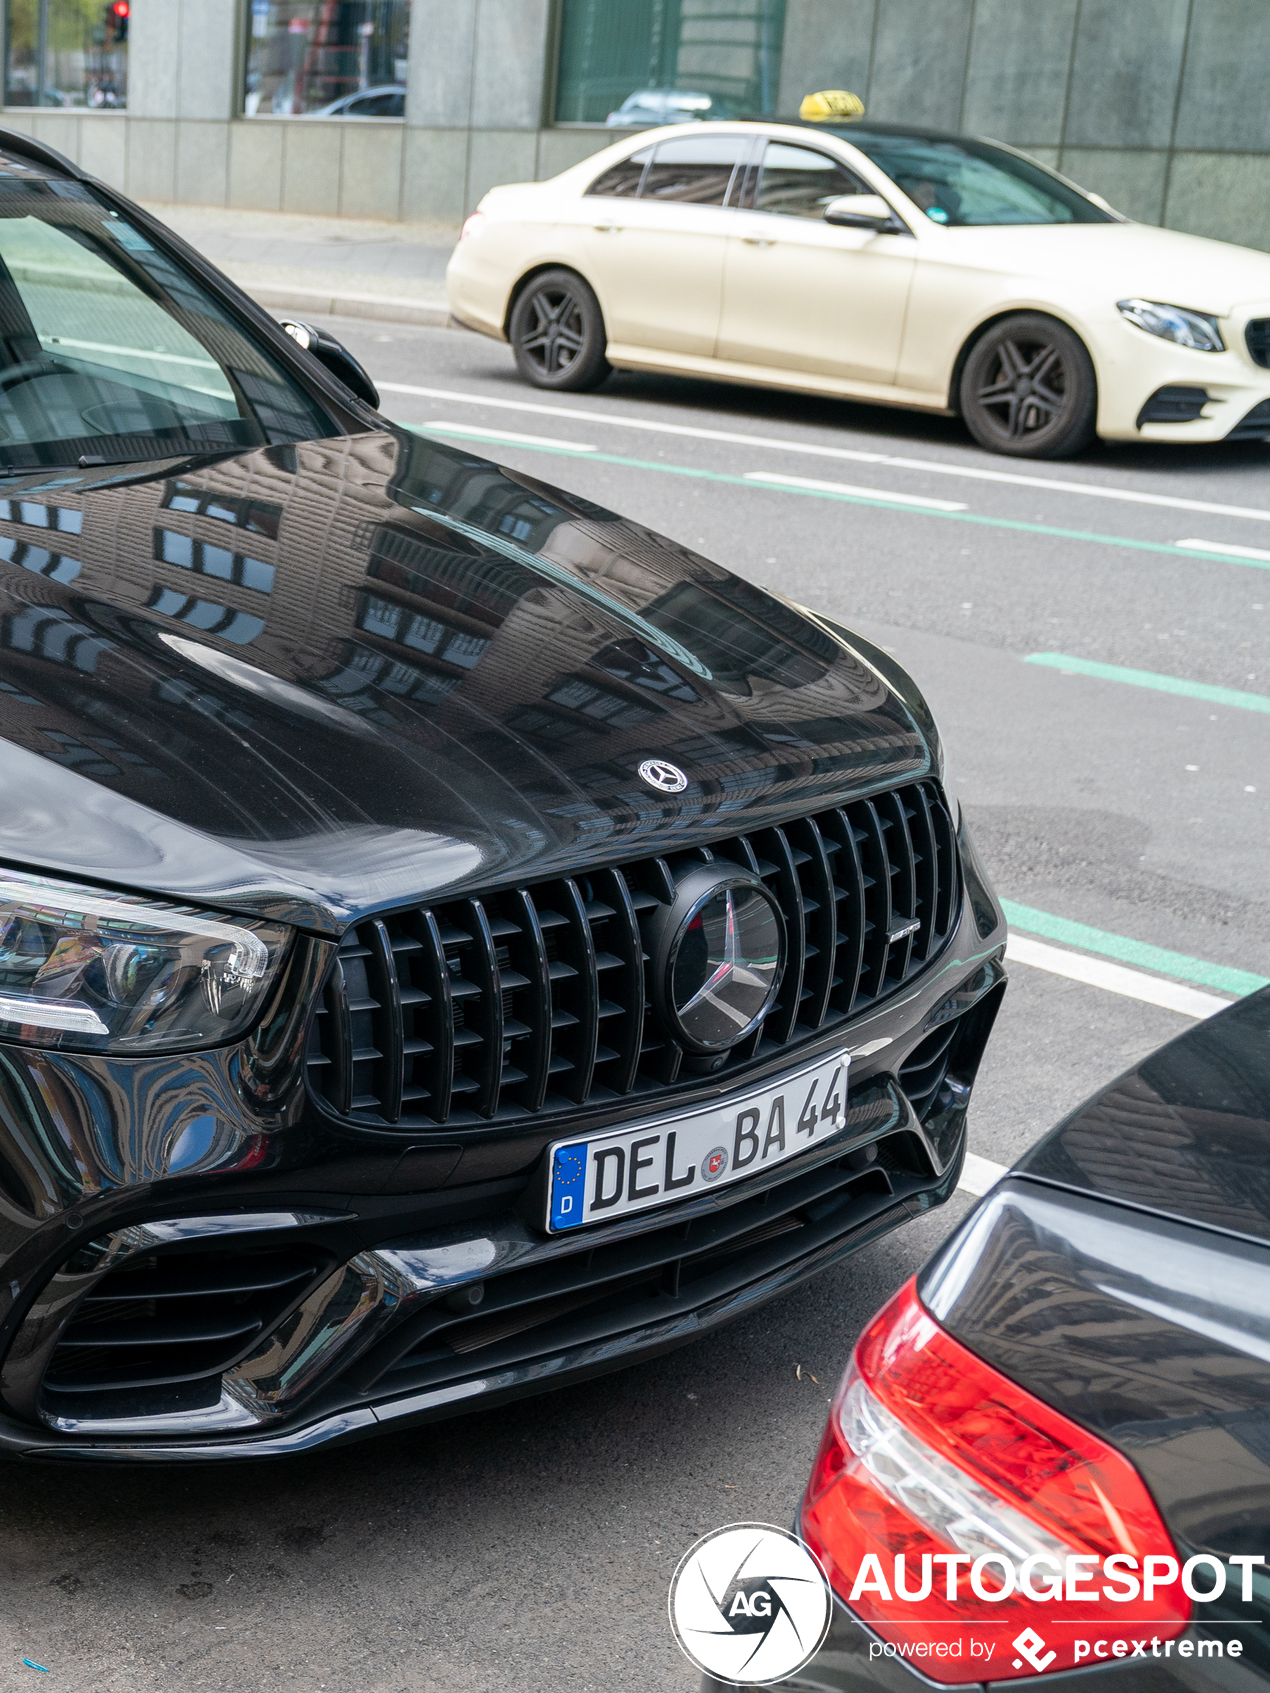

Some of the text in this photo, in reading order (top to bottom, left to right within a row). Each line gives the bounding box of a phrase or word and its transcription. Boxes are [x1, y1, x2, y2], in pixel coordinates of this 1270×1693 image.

[590, 1130, 695, 1211] DEL
[732, 1094, 786, 1171] BA
[796, 1065, 842, 1138] 44
[561, 1196, 573, 1214] D
